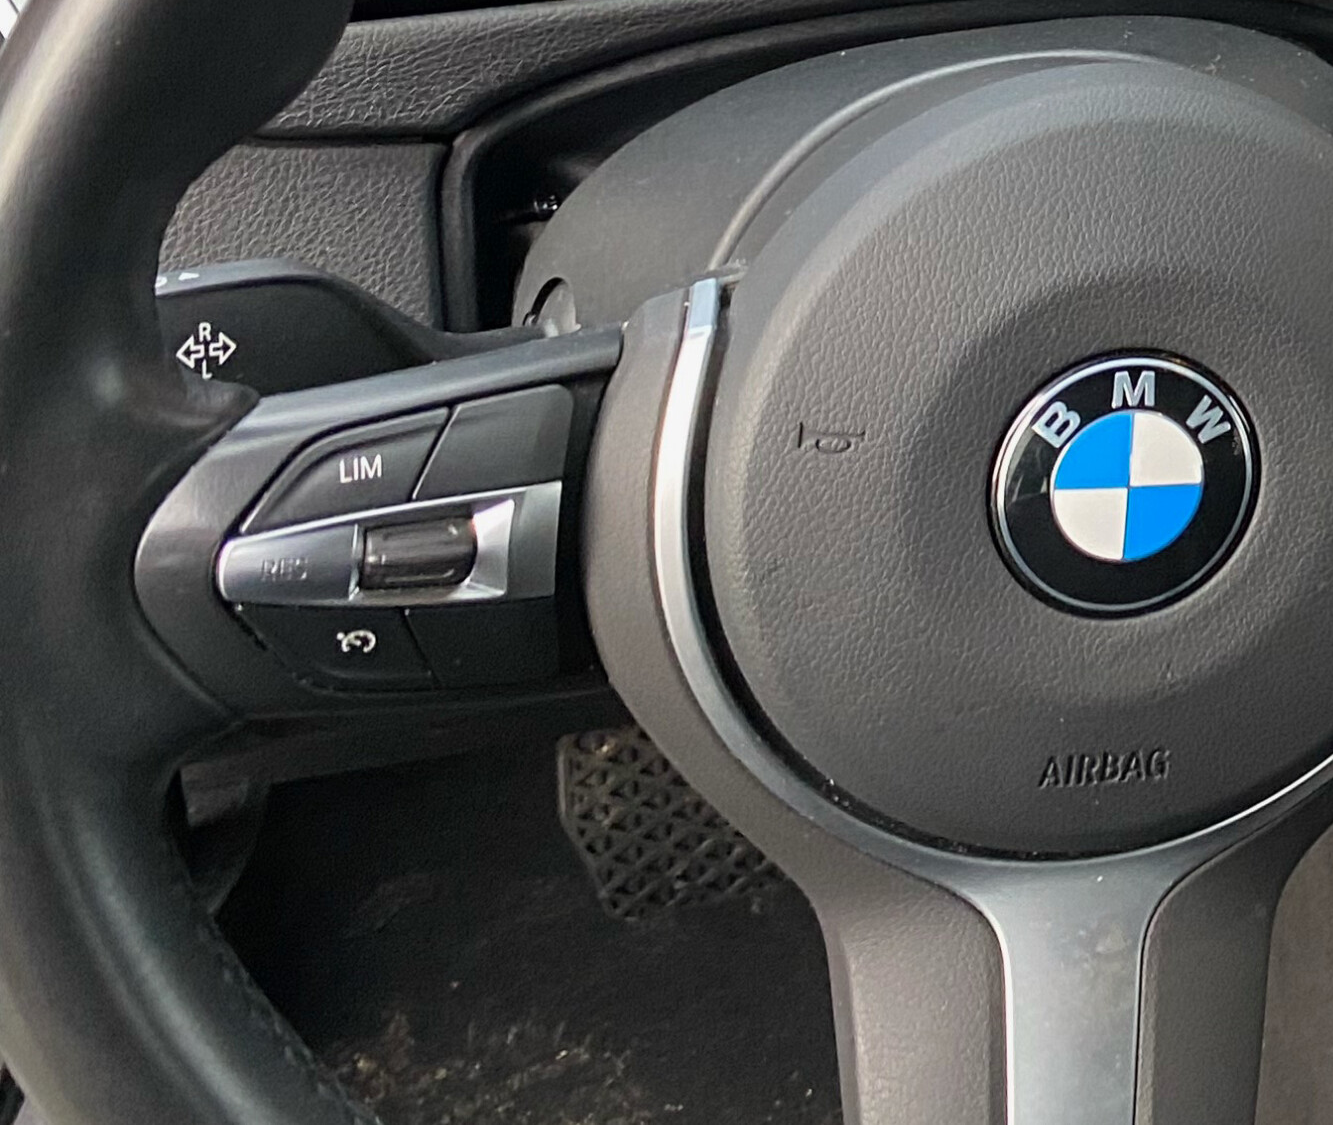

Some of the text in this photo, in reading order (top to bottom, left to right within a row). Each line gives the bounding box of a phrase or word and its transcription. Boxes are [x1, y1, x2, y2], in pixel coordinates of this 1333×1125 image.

[199, 322, 212, 342] R
[202, 359, 212, 379] L
[1031, 370, 1231, 449] BMW
[339, 454, 383, 484] LIM
[1038, 748, 1171, 790] AIRBAG
